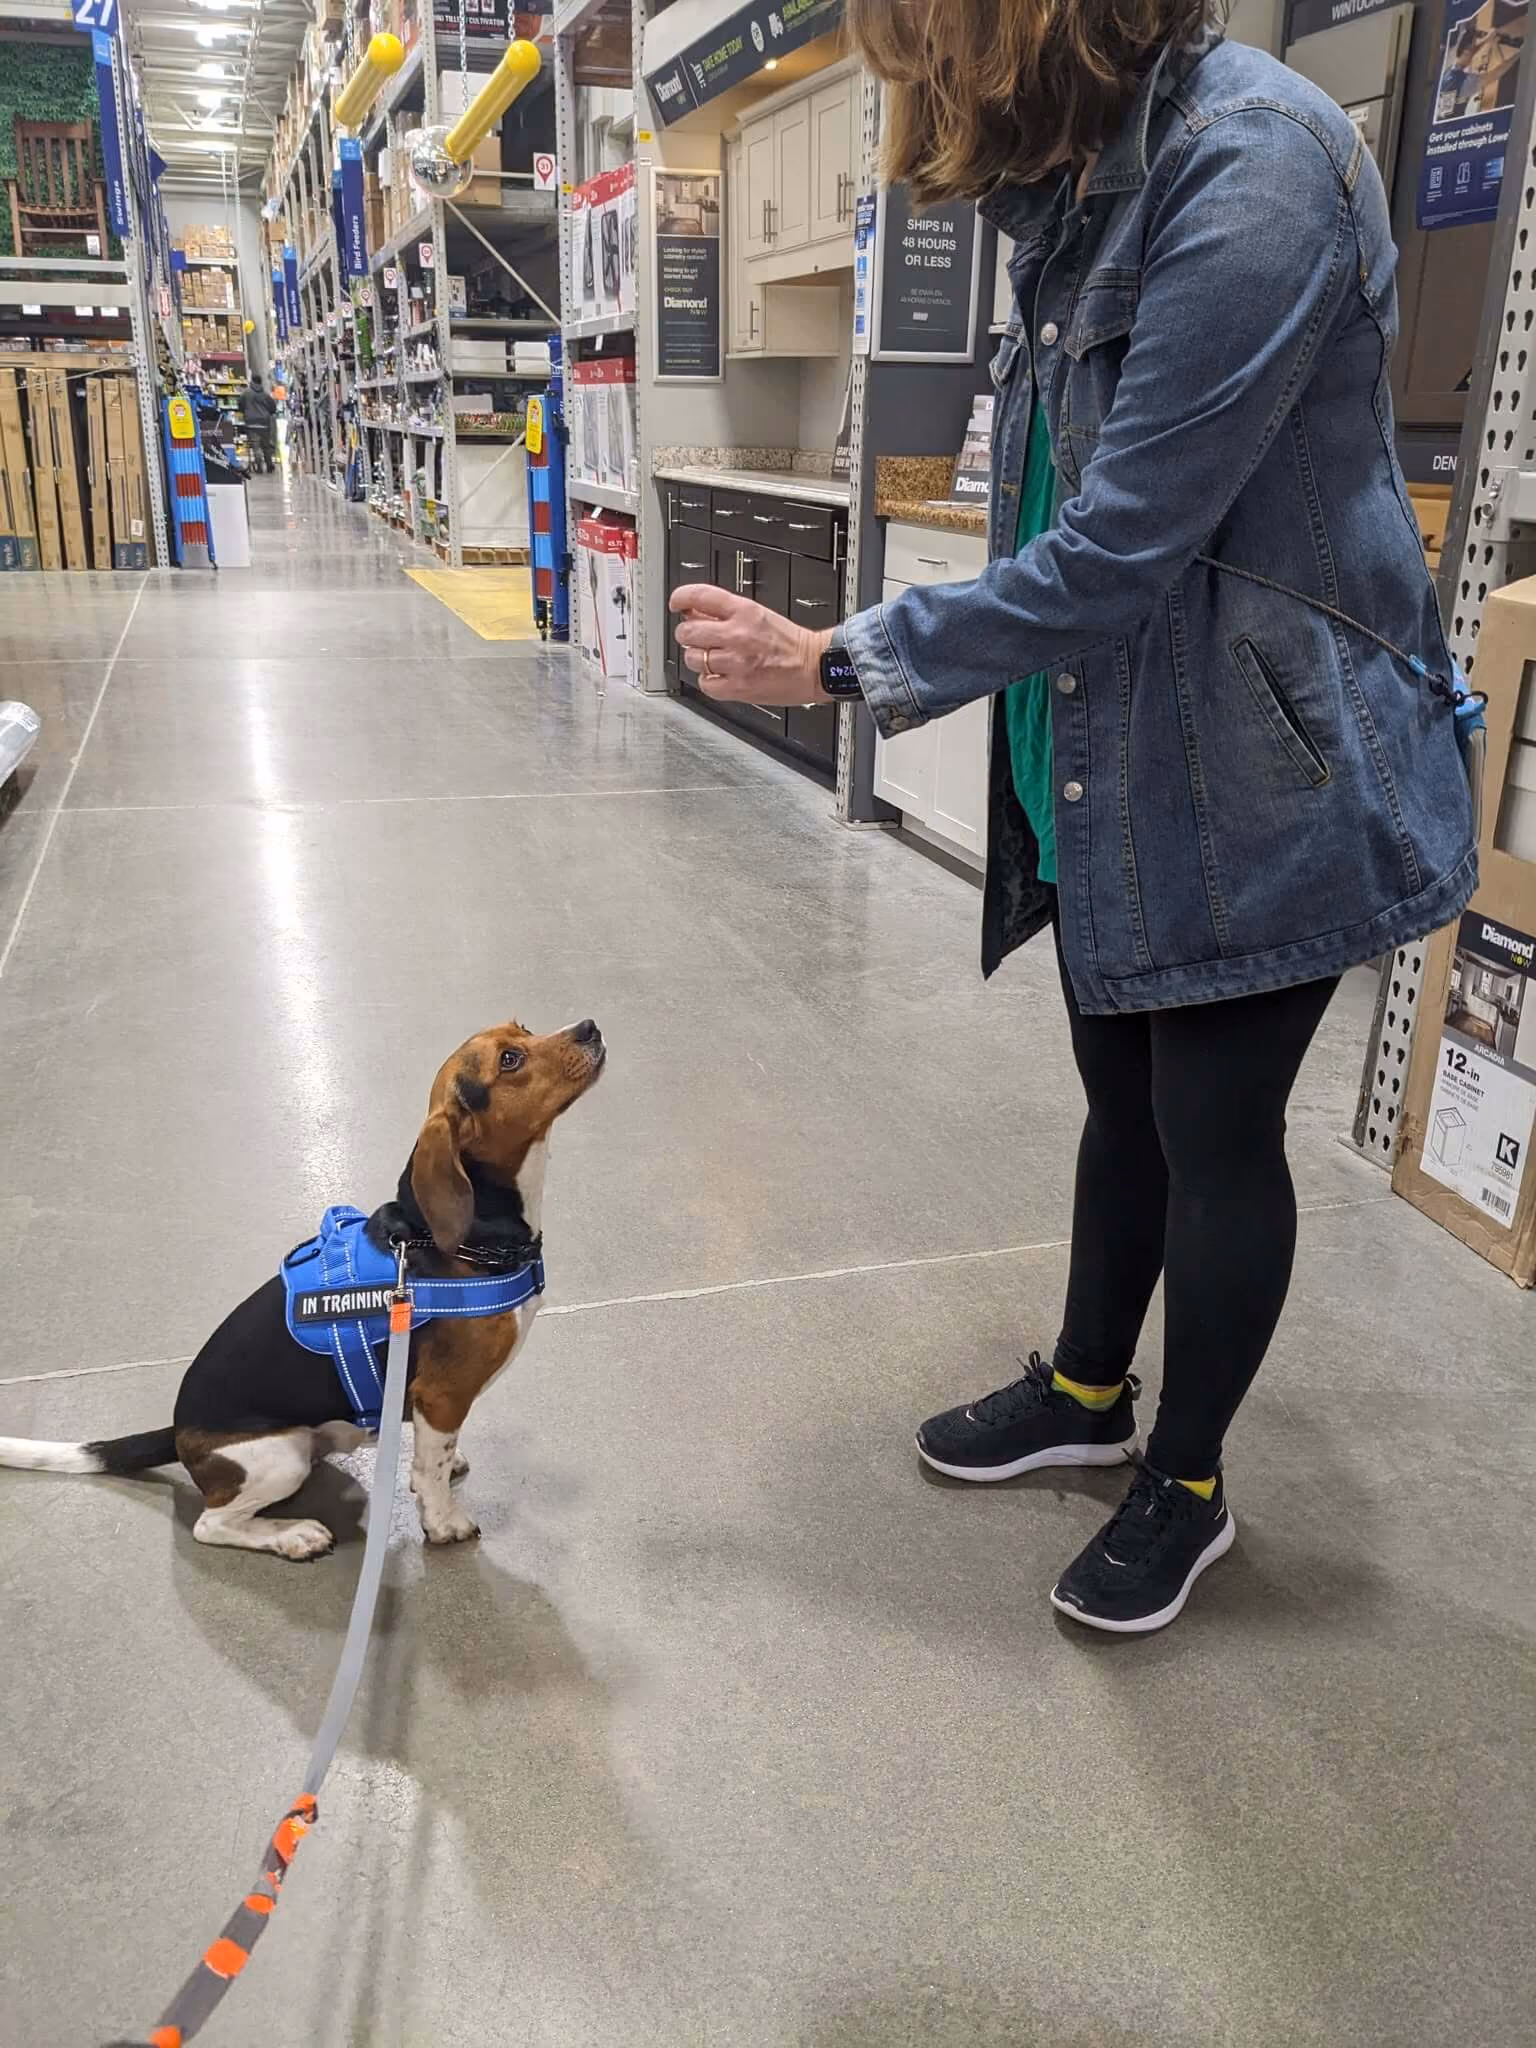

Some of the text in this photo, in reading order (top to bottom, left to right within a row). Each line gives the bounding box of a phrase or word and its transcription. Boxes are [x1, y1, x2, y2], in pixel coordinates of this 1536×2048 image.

[76, 0, 113, 26] 27
[655, 70, 683, 102] Diamond
[1426, 129, 1511, 156] installed through Lowe'
[1429, 122, 1494, 143] Get your cabinets
[113, 180, 124, 225] Swings
[906, 218, 954, 233] SHIPS IN
[352, 215, 362, 269] Bird Feeders
[902, 236, 957, 250] 48 HOURS
[904, 254, 952, 268] OR LESS
[664, 296, 707, 309] Diamond
[1433, 455, 1458, 470] DEN
[1481, 922, 1535, 960] Diamond
[1510, 952, 1531, 968] NOW
[1446, 1047, 1480, 1082] 12-in
[1474, 1044, 1505, 1067] ARCADIA
[1442, 1069, 1485, 1098] BASE CABINET
[302, 1290, 392, 1315] IN TRAINING
